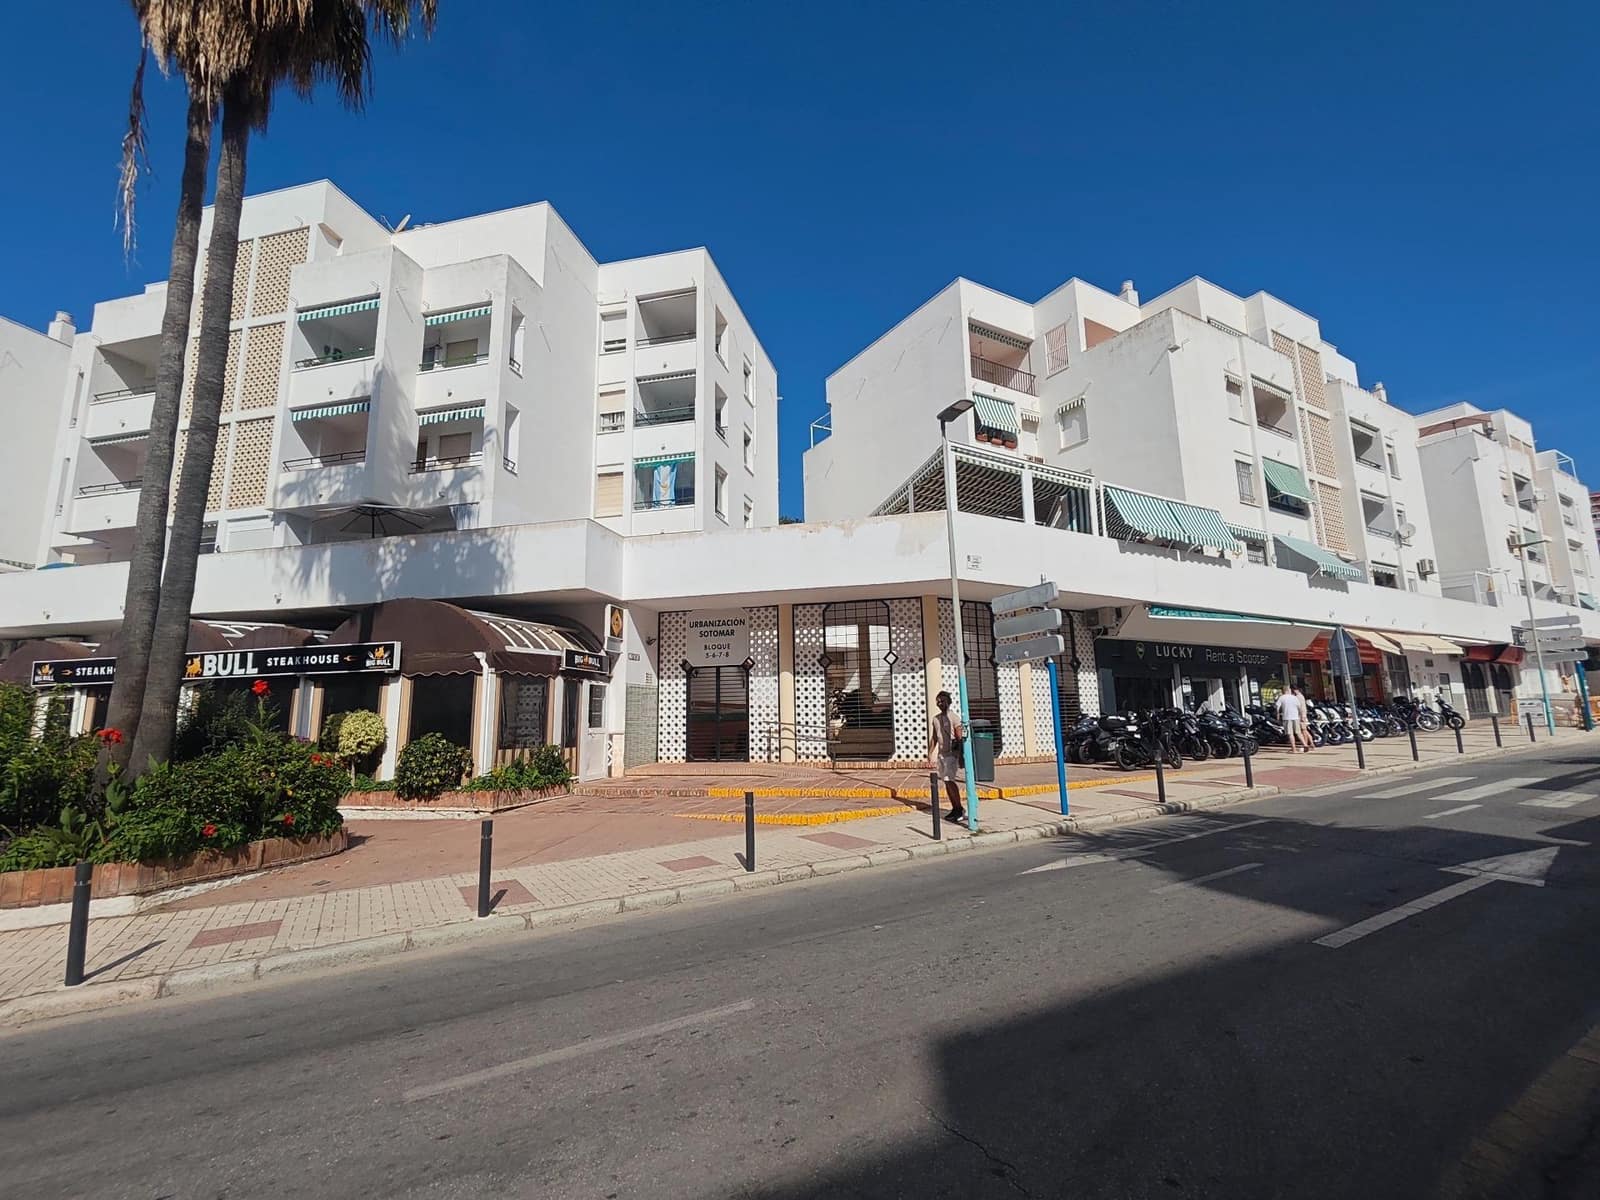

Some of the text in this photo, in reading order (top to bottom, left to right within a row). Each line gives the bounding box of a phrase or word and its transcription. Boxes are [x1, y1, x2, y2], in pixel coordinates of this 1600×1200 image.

[689, 617, 746, 628] URBANIZACIÓN
[699, 629, 735, 637] SOTOMAR
[1155, 645, 1270, 665] LUCKY Rent a Scooter
[202, 652, 339, 676] BULL STEAKHOUSE
[75, 666, 116, 676] STEAKH
